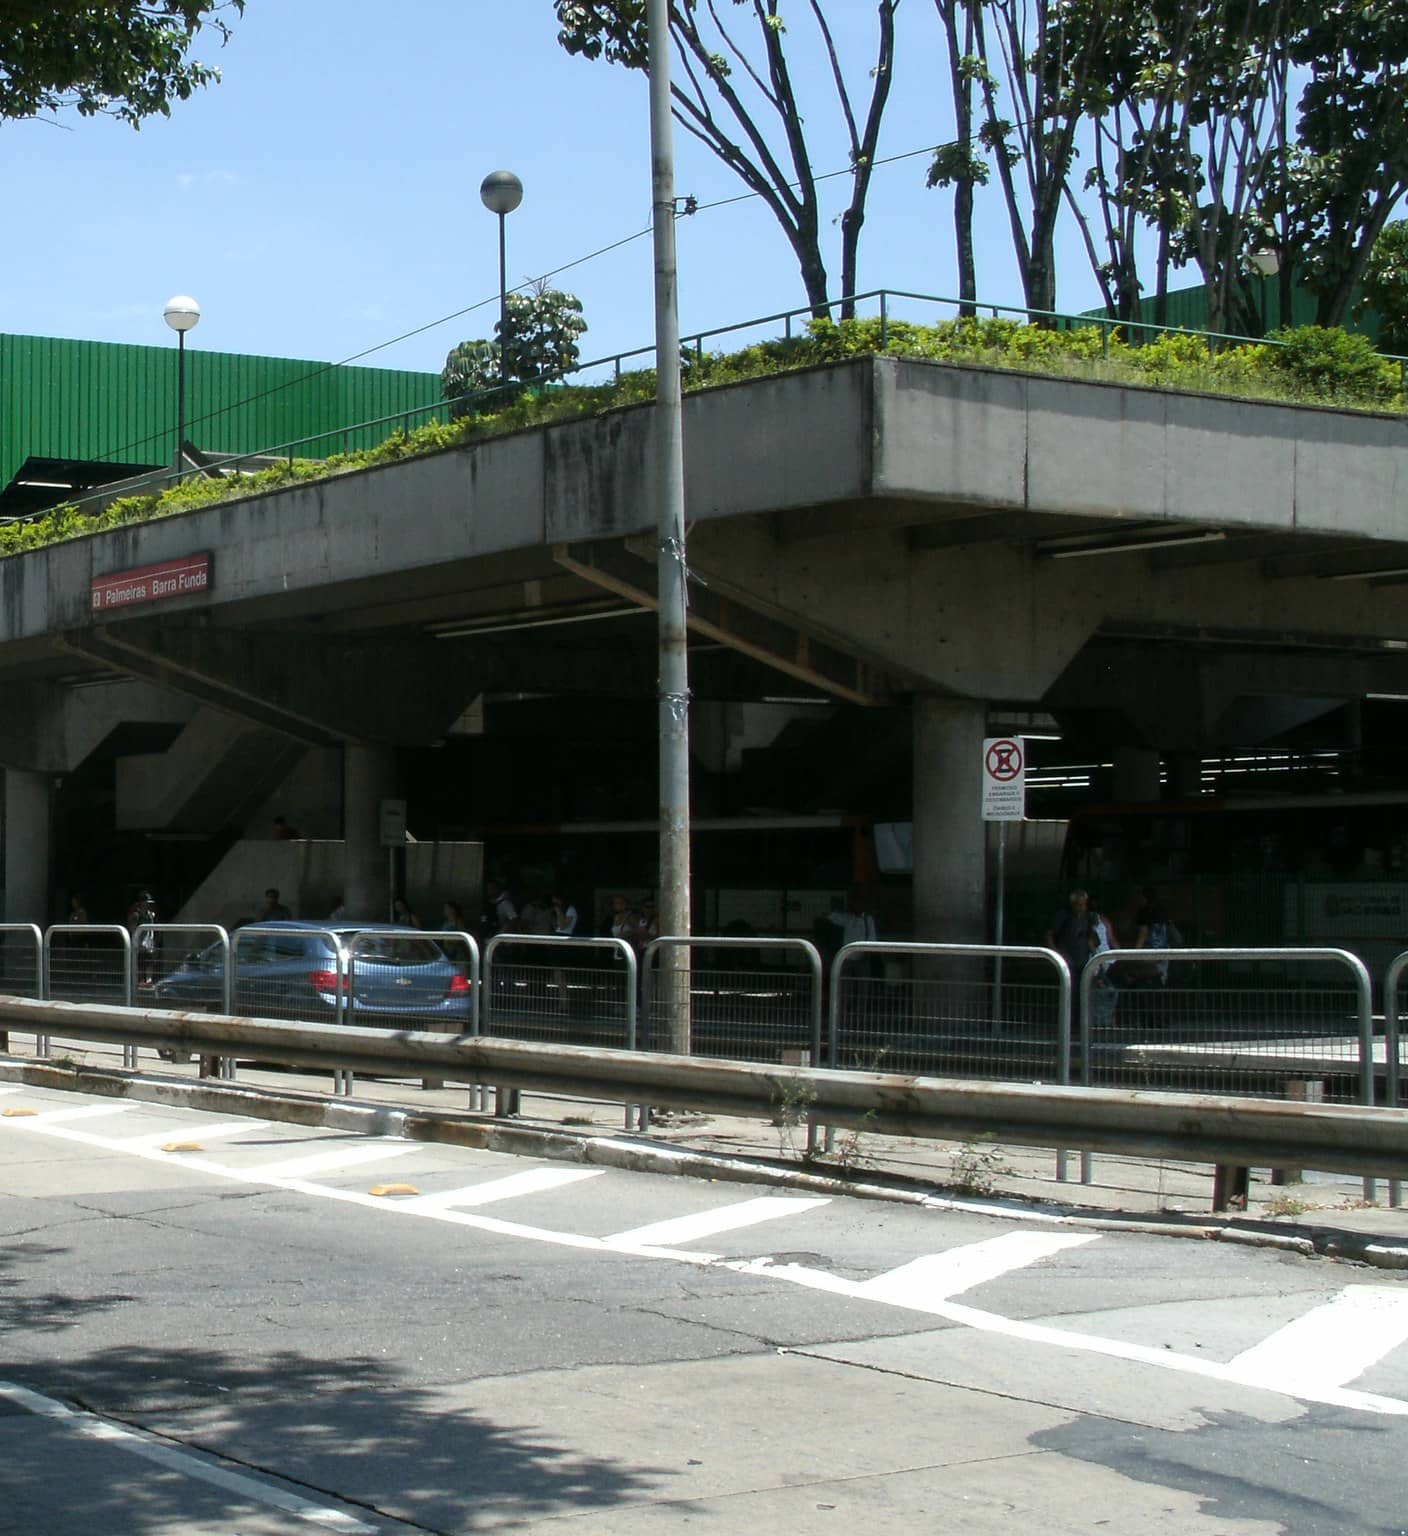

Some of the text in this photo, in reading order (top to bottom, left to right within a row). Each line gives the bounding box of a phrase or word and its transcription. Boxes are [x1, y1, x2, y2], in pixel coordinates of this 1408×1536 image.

[106, 571, 208, 605] Palmeiras Barra Funda
